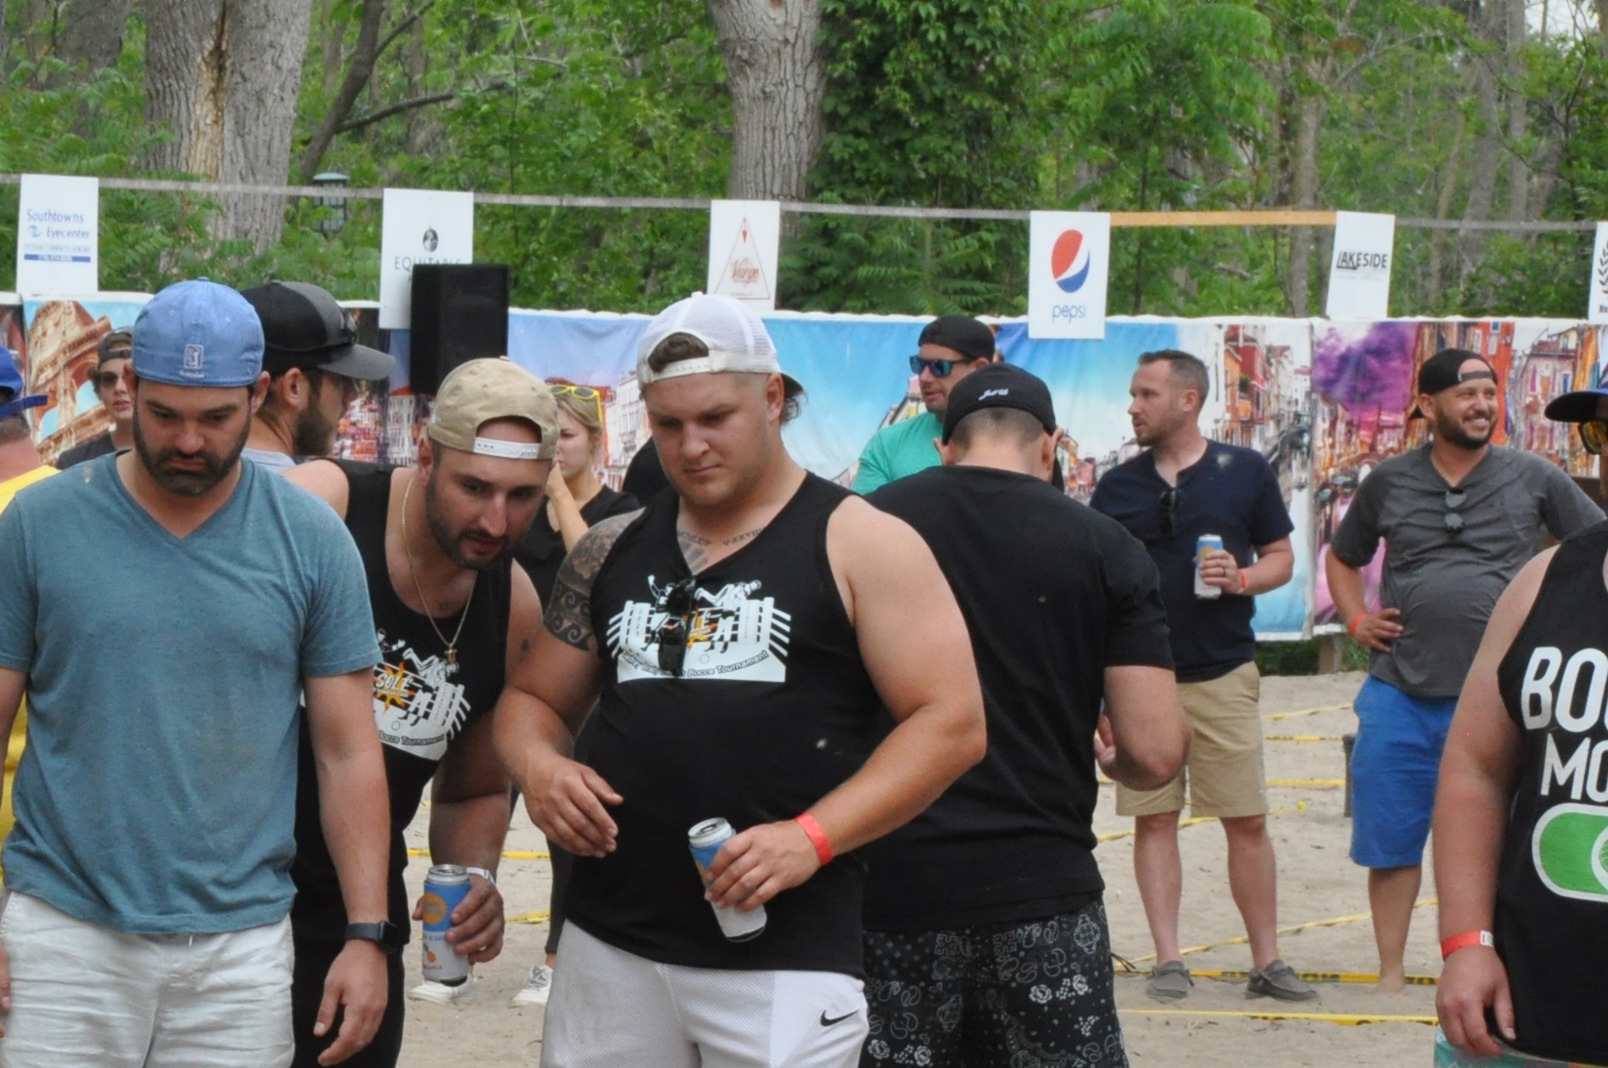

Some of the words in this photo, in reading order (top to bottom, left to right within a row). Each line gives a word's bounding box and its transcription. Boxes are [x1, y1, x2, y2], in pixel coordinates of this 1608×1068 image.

[26, 208, 84, 224] Southtowns
[47, 226, 90, 241] Eyecenter
[1336, 251, 1388, 270] LAKESIDE
[1052, 304, 1086, 323] pepsi
[716, 648, 770, 675] Tournament
[1521, 647, 1608, 732] BO
[401, 733, 446, 746] Tournament
